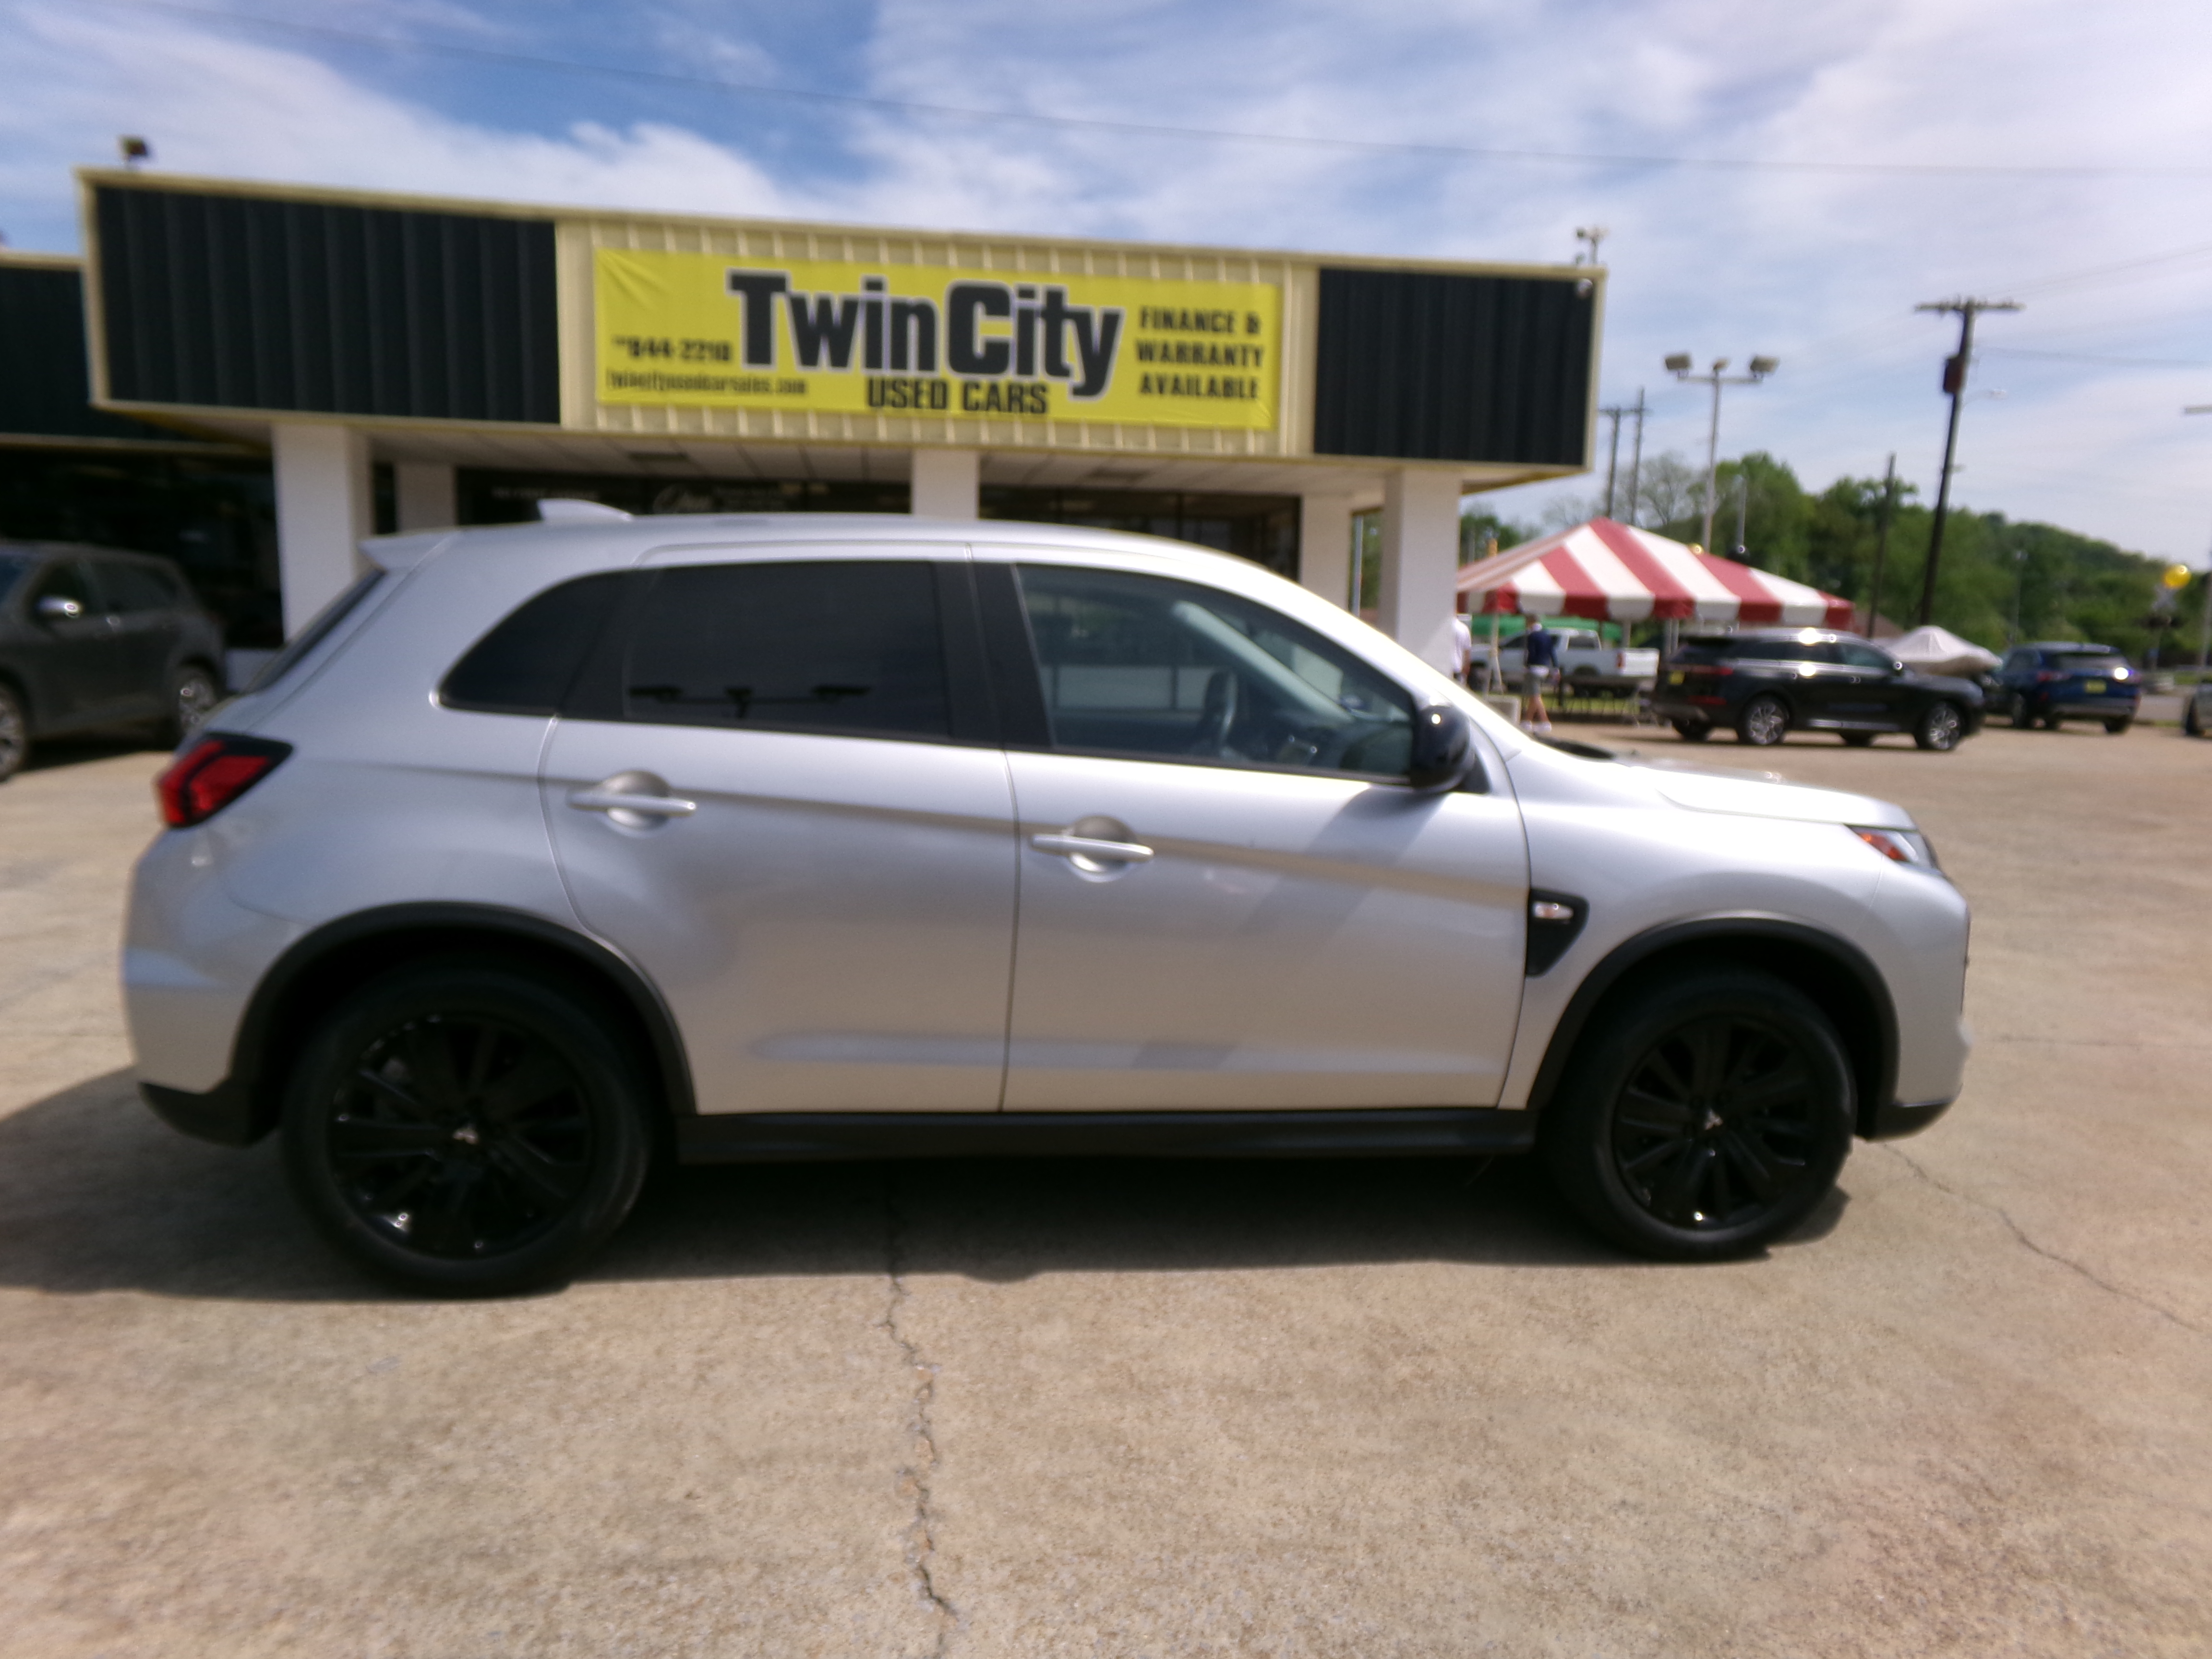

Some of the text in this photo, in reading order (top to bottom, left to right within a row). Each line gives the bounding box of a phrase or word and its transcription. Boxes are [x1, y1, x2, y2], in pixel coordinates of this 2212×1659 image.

[1140, 306, 1235, 334] FINANCE
[1136, 339, 1263, 367] WARRANTY
[868, 377, 1047, 414] USED CARS
[1139, 372, 1259, 399] AVAILABLE
